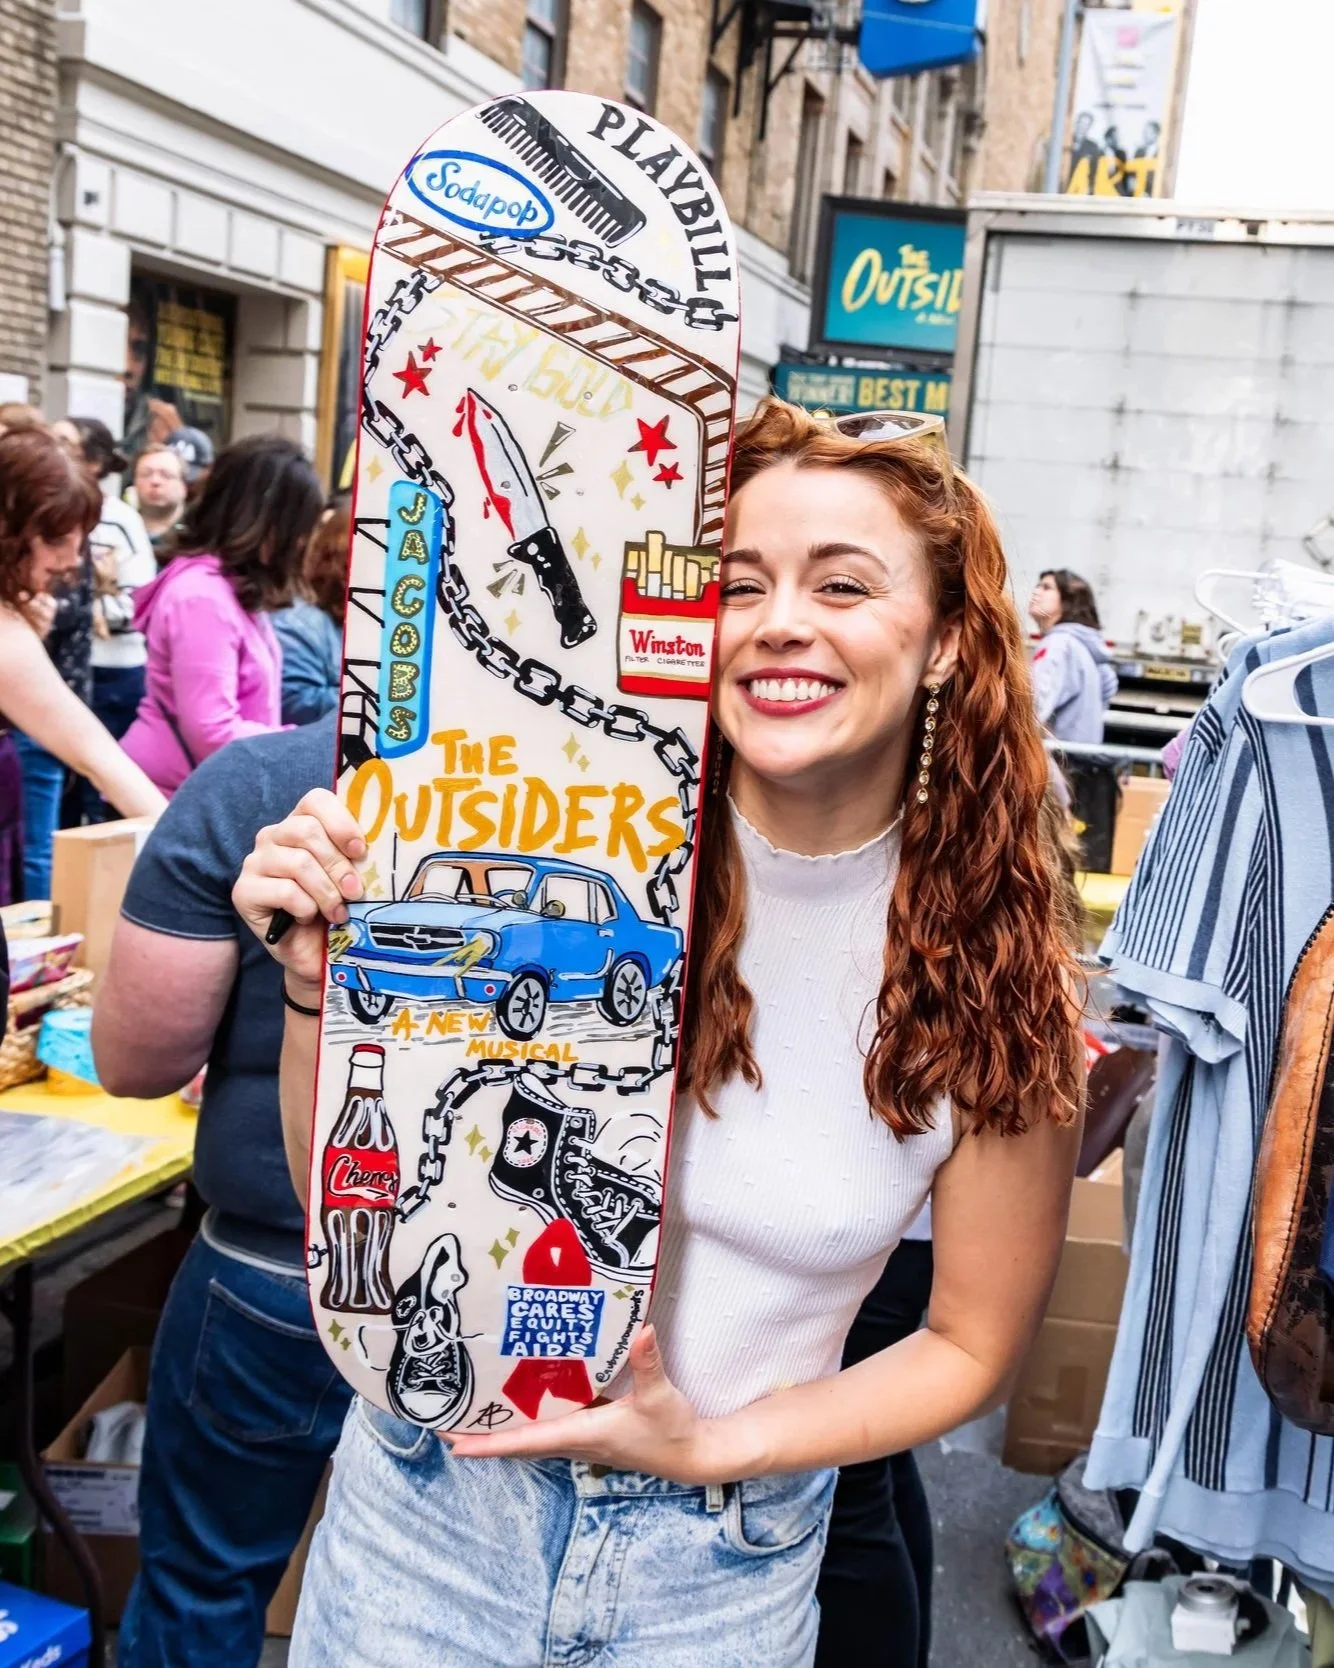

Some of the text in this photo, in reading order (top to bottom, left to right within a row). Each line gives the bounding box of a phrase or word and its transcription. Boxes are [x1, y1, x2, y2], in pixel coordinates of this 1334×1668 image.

[1067, 155, 1157, 197] ART
[426, 161, 539, 227] Sodapop
[587, 102, 732, 292] PLAYBILL
[857, 376, 921, 410] BEST
[384, 491, 430, 742] JACOBS
[628, 629, 706, 657] Winston
[431, 729, 519, 776] THE
[347, 757, 687, 873] OUTSIDERS
[391, 1008, 490, 1040] A NEW
[465, 1038, 580, 1062] MUSICAL
[327, 1154, 399, 1198] Cherry
[507, 1287, 603, 1305] BROADWAY
[510, 1302, 596, 1320] CARES
[508, 1331, 594, 1345] FIGHTS
[510, 1317, 595, 1333] EQUITY
[510, 1341, 588, 1357] AIDS
